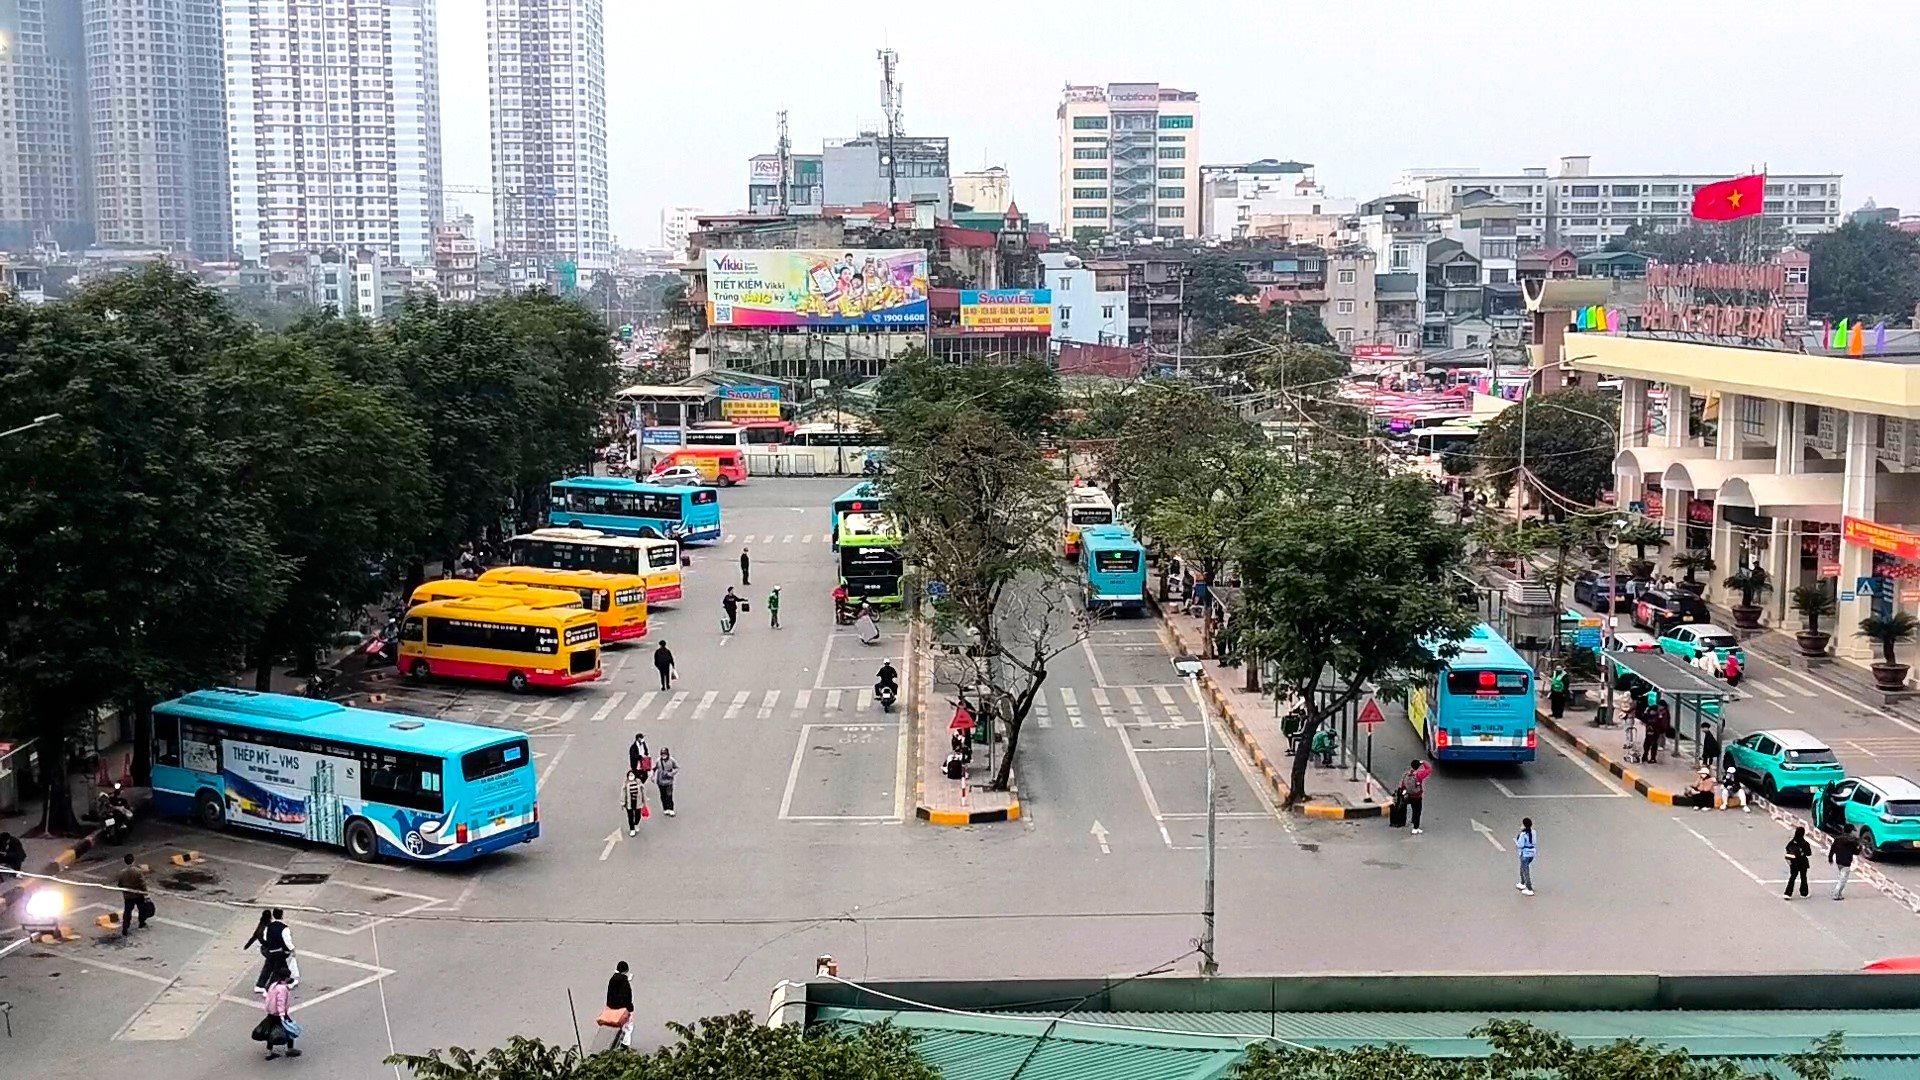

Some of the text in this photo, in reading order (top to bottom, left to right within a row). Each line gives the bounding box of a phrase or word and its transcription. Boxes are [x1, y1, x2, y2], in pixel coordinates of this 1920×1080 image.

[713, 254, 743, 271] Vikki
[883, 314, 903, 322] 1900
[279, 754, 300, 770] VMS
